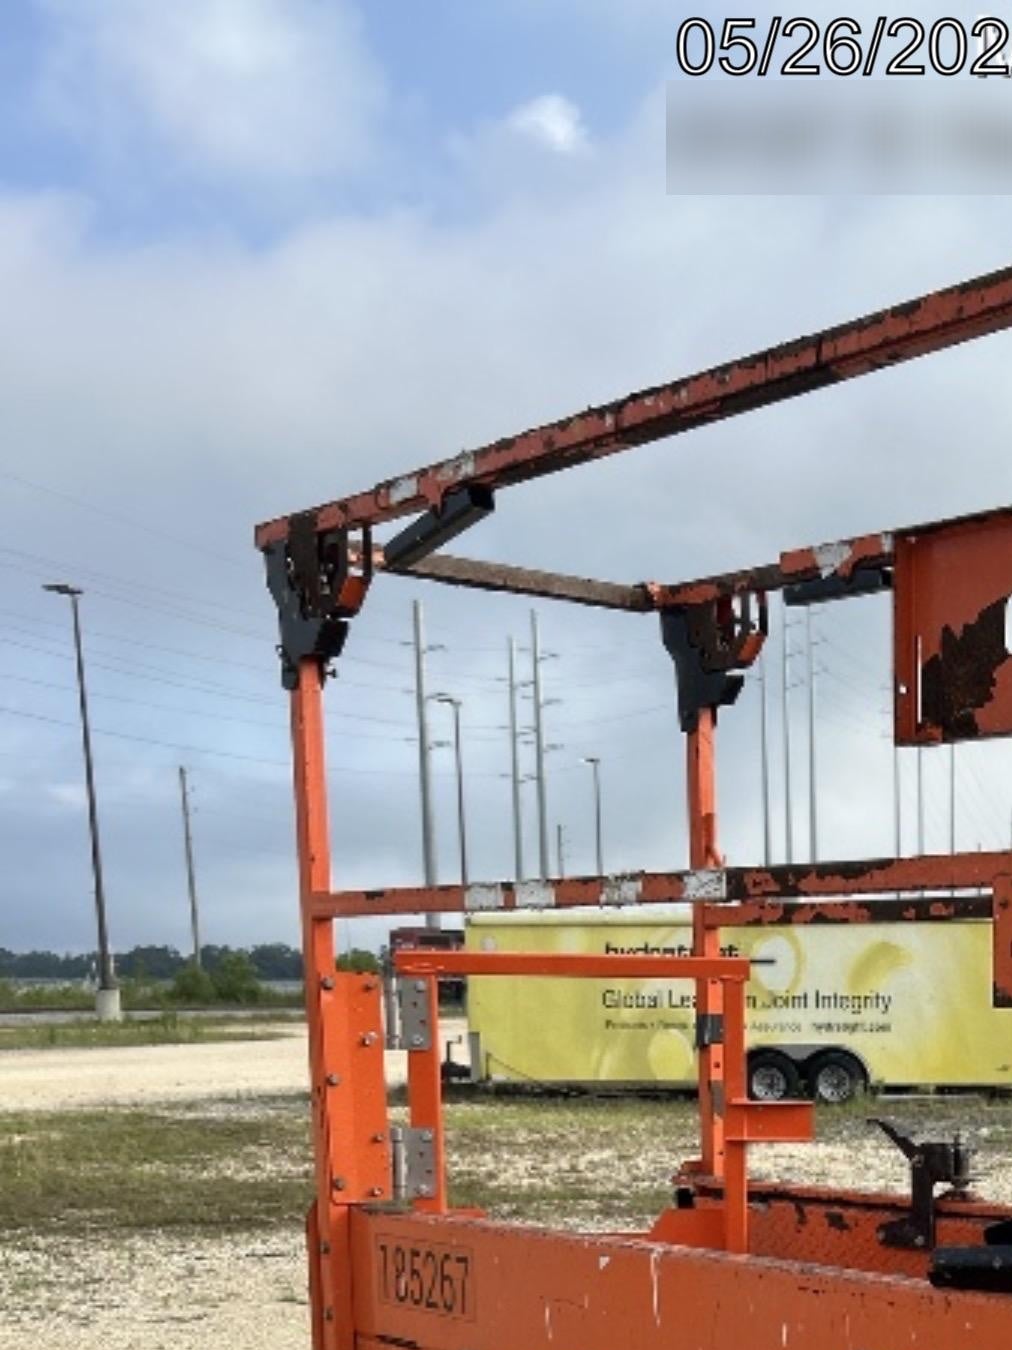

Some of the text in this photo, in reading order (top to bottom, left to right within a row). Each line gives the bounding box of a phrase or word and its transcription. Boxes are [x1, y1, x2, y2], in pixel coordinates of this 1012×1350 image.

[602, 989, 663, 1009] Global
[759, 989, 809, 1009] Joint
[815, 989, 892, 1014] Integrity
[380, 1244, 469, 1315] 185267
